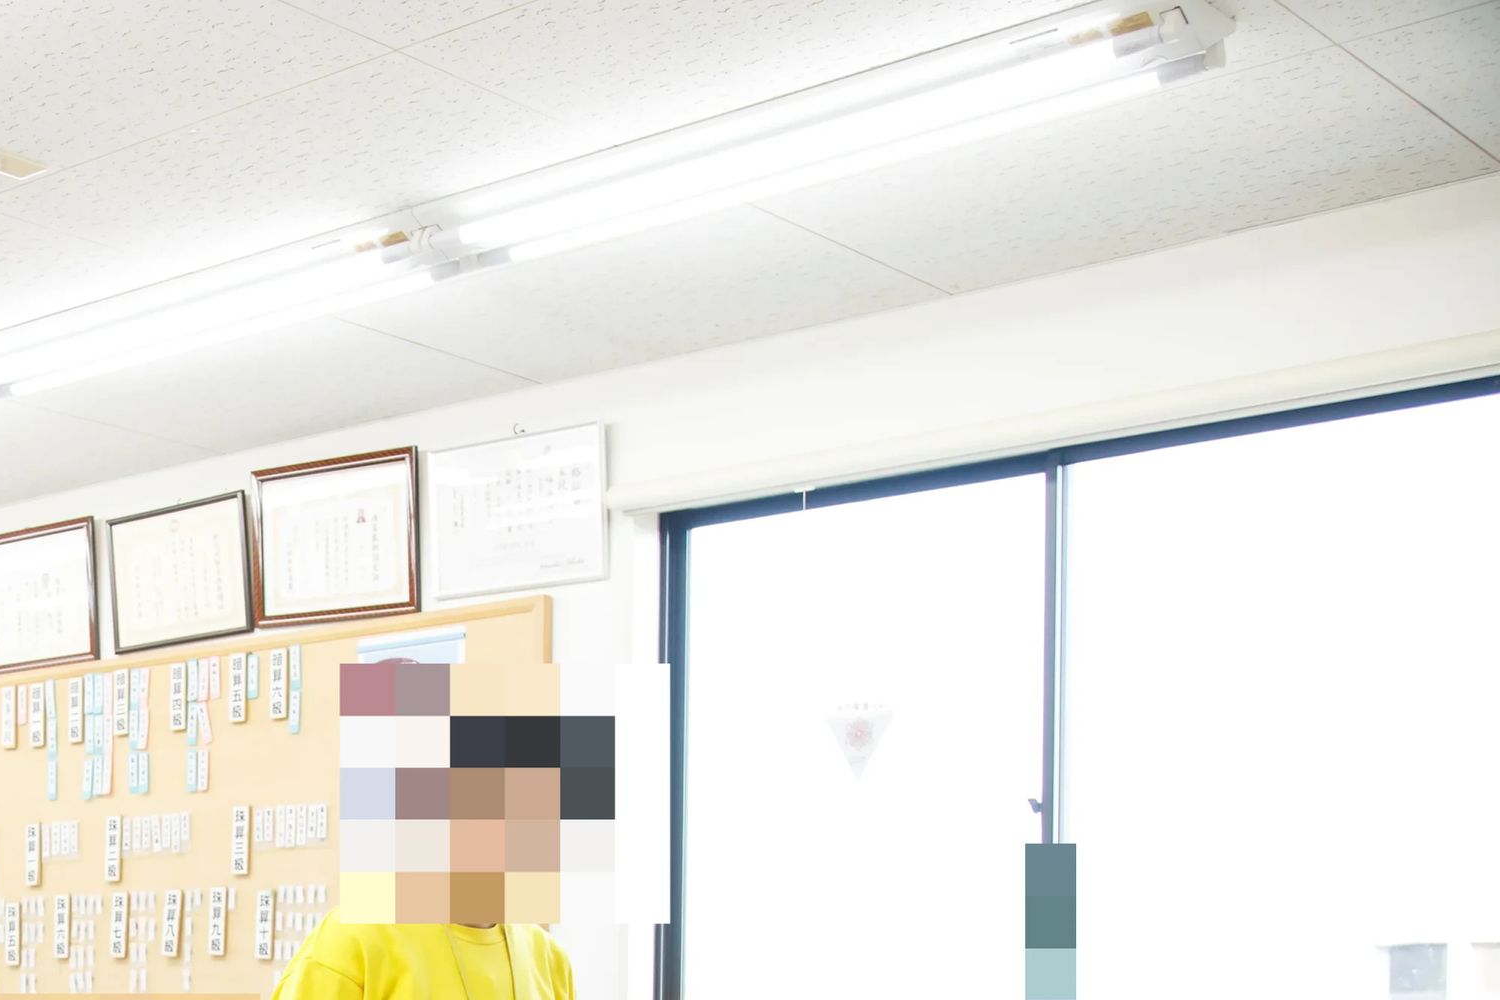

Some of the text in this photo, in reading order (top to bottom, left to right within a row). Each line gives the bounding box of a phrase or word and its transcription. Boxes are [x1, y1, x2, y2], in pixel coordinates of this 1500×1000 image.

[231, 656, 244, 719] 暗算五級
[271, 652, 284, 715] 暗算六級
[26, 825, 37, 883] 珠算一級
[106, 818, 118, 879] 珠算二級
[234, 809, 246, 872] 珠算三級
[111, 895, 125, 955] 珠算七級
[164, 893, 178, 954] 珠算八級
[210, 890, 223, 952] 珠算九級
[258, 894, 271, 957] 珠算十級
